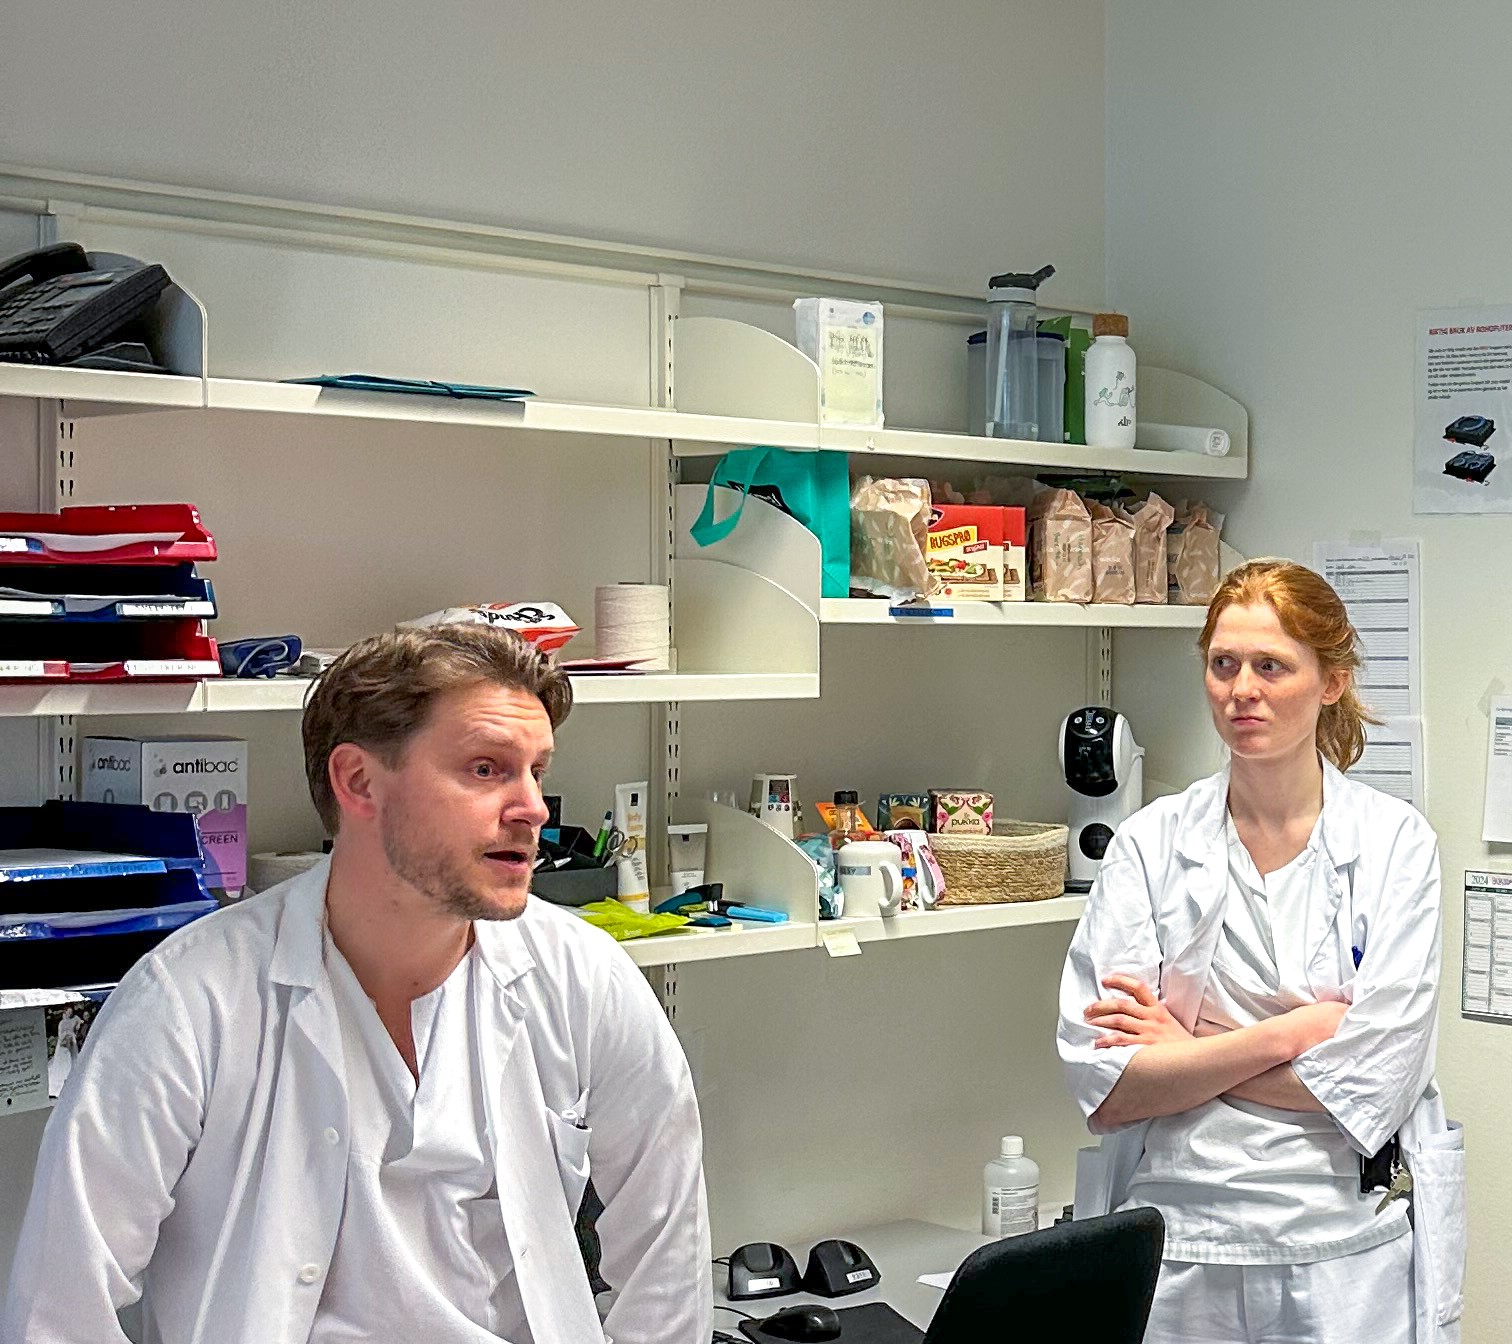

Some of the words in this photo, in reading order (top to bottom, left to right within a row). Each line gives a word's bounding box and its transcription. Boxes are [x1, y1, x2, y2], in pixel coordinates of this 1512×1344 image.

[96, 755, 131, 772] antibac
[172, 754, 238, 774] antibac
[951, 818, 980, 827] pukka
[201, 833, 239, 846] CREEN
